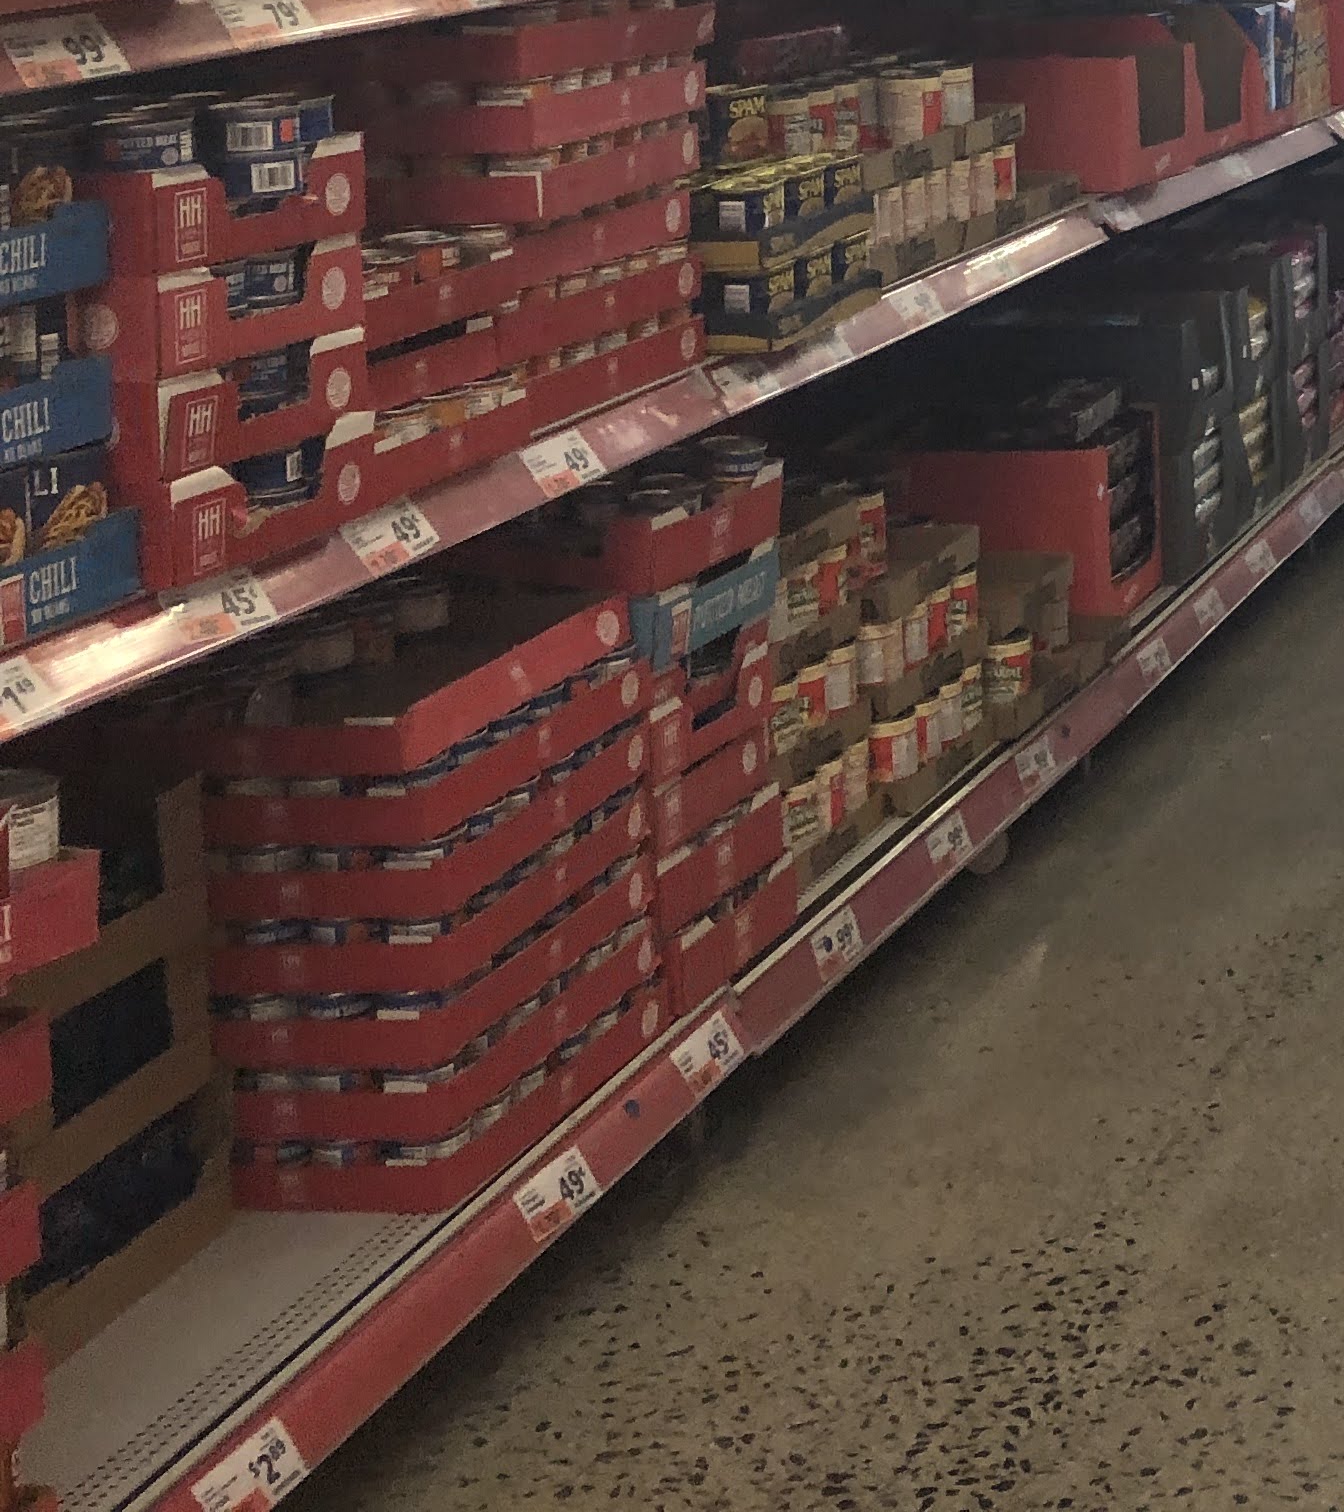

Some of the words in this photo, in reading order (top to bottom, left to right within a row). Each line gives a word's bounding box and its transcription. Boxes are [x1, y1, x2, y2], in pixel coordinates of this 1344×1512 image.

[729, 95, 765, 119] SPAM
[179, 194, 201, 228] HH
[179, 295, 201, 330] HH
[2, 397, 50, 443] CHILI
[188, 402, 211, 437] HH
[198, 504, 221, 539] HH
[29, 556, 78, 604] CHILI
